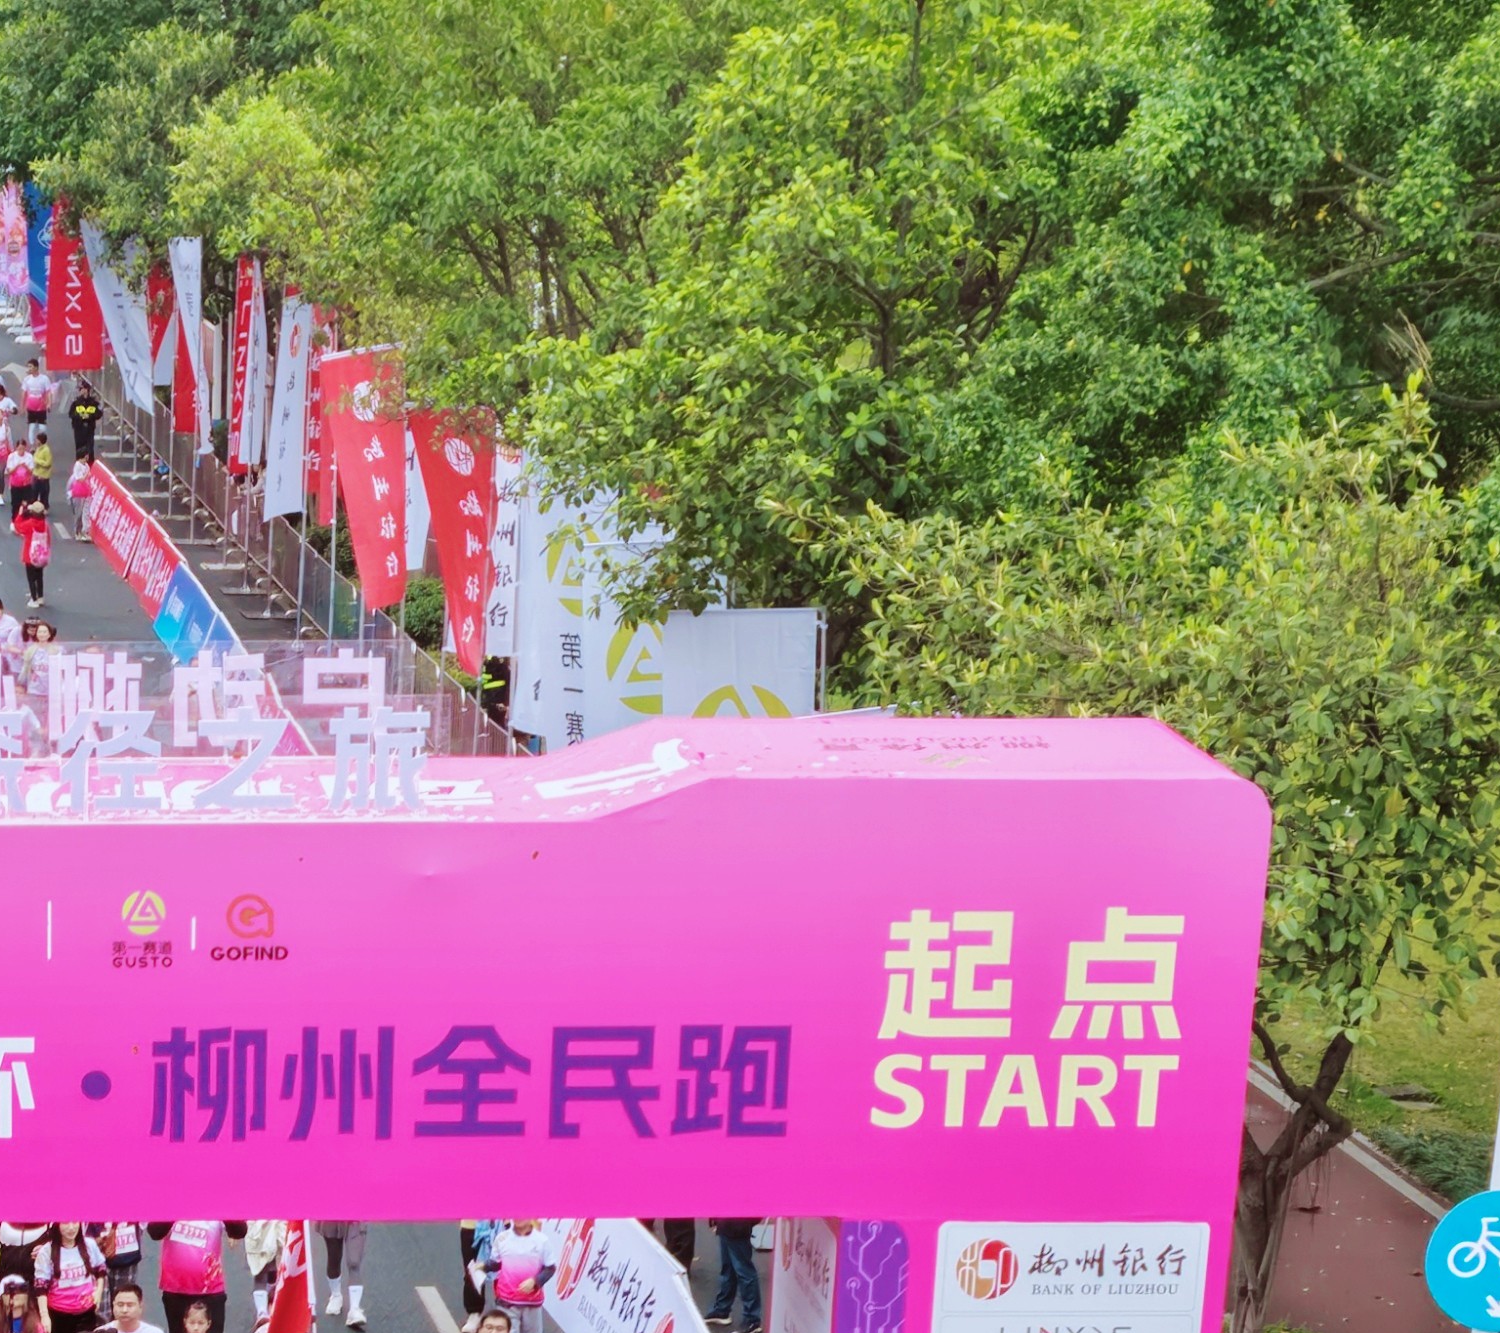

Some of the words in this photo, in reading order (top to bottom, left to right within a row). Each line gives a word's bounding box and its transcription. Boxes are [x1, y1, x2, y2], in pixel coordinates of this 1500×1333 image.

[112, 941, 172, 955] 第一赛道
[210, 946, 288, 960] GOFIND
[113, 956, 172, 968] GUSTO
[878, 906, 1185, 1042] 起点
[870, 1054, 1181, 1130] START
[1028, 1243, 1186, 1277] 柳州银行
[1032, 1284, 1074, 1295] BANK
[1081, 1284, 1102, 1295] OF
[1108, 1284, 1178, 1295] LIUZHOU
